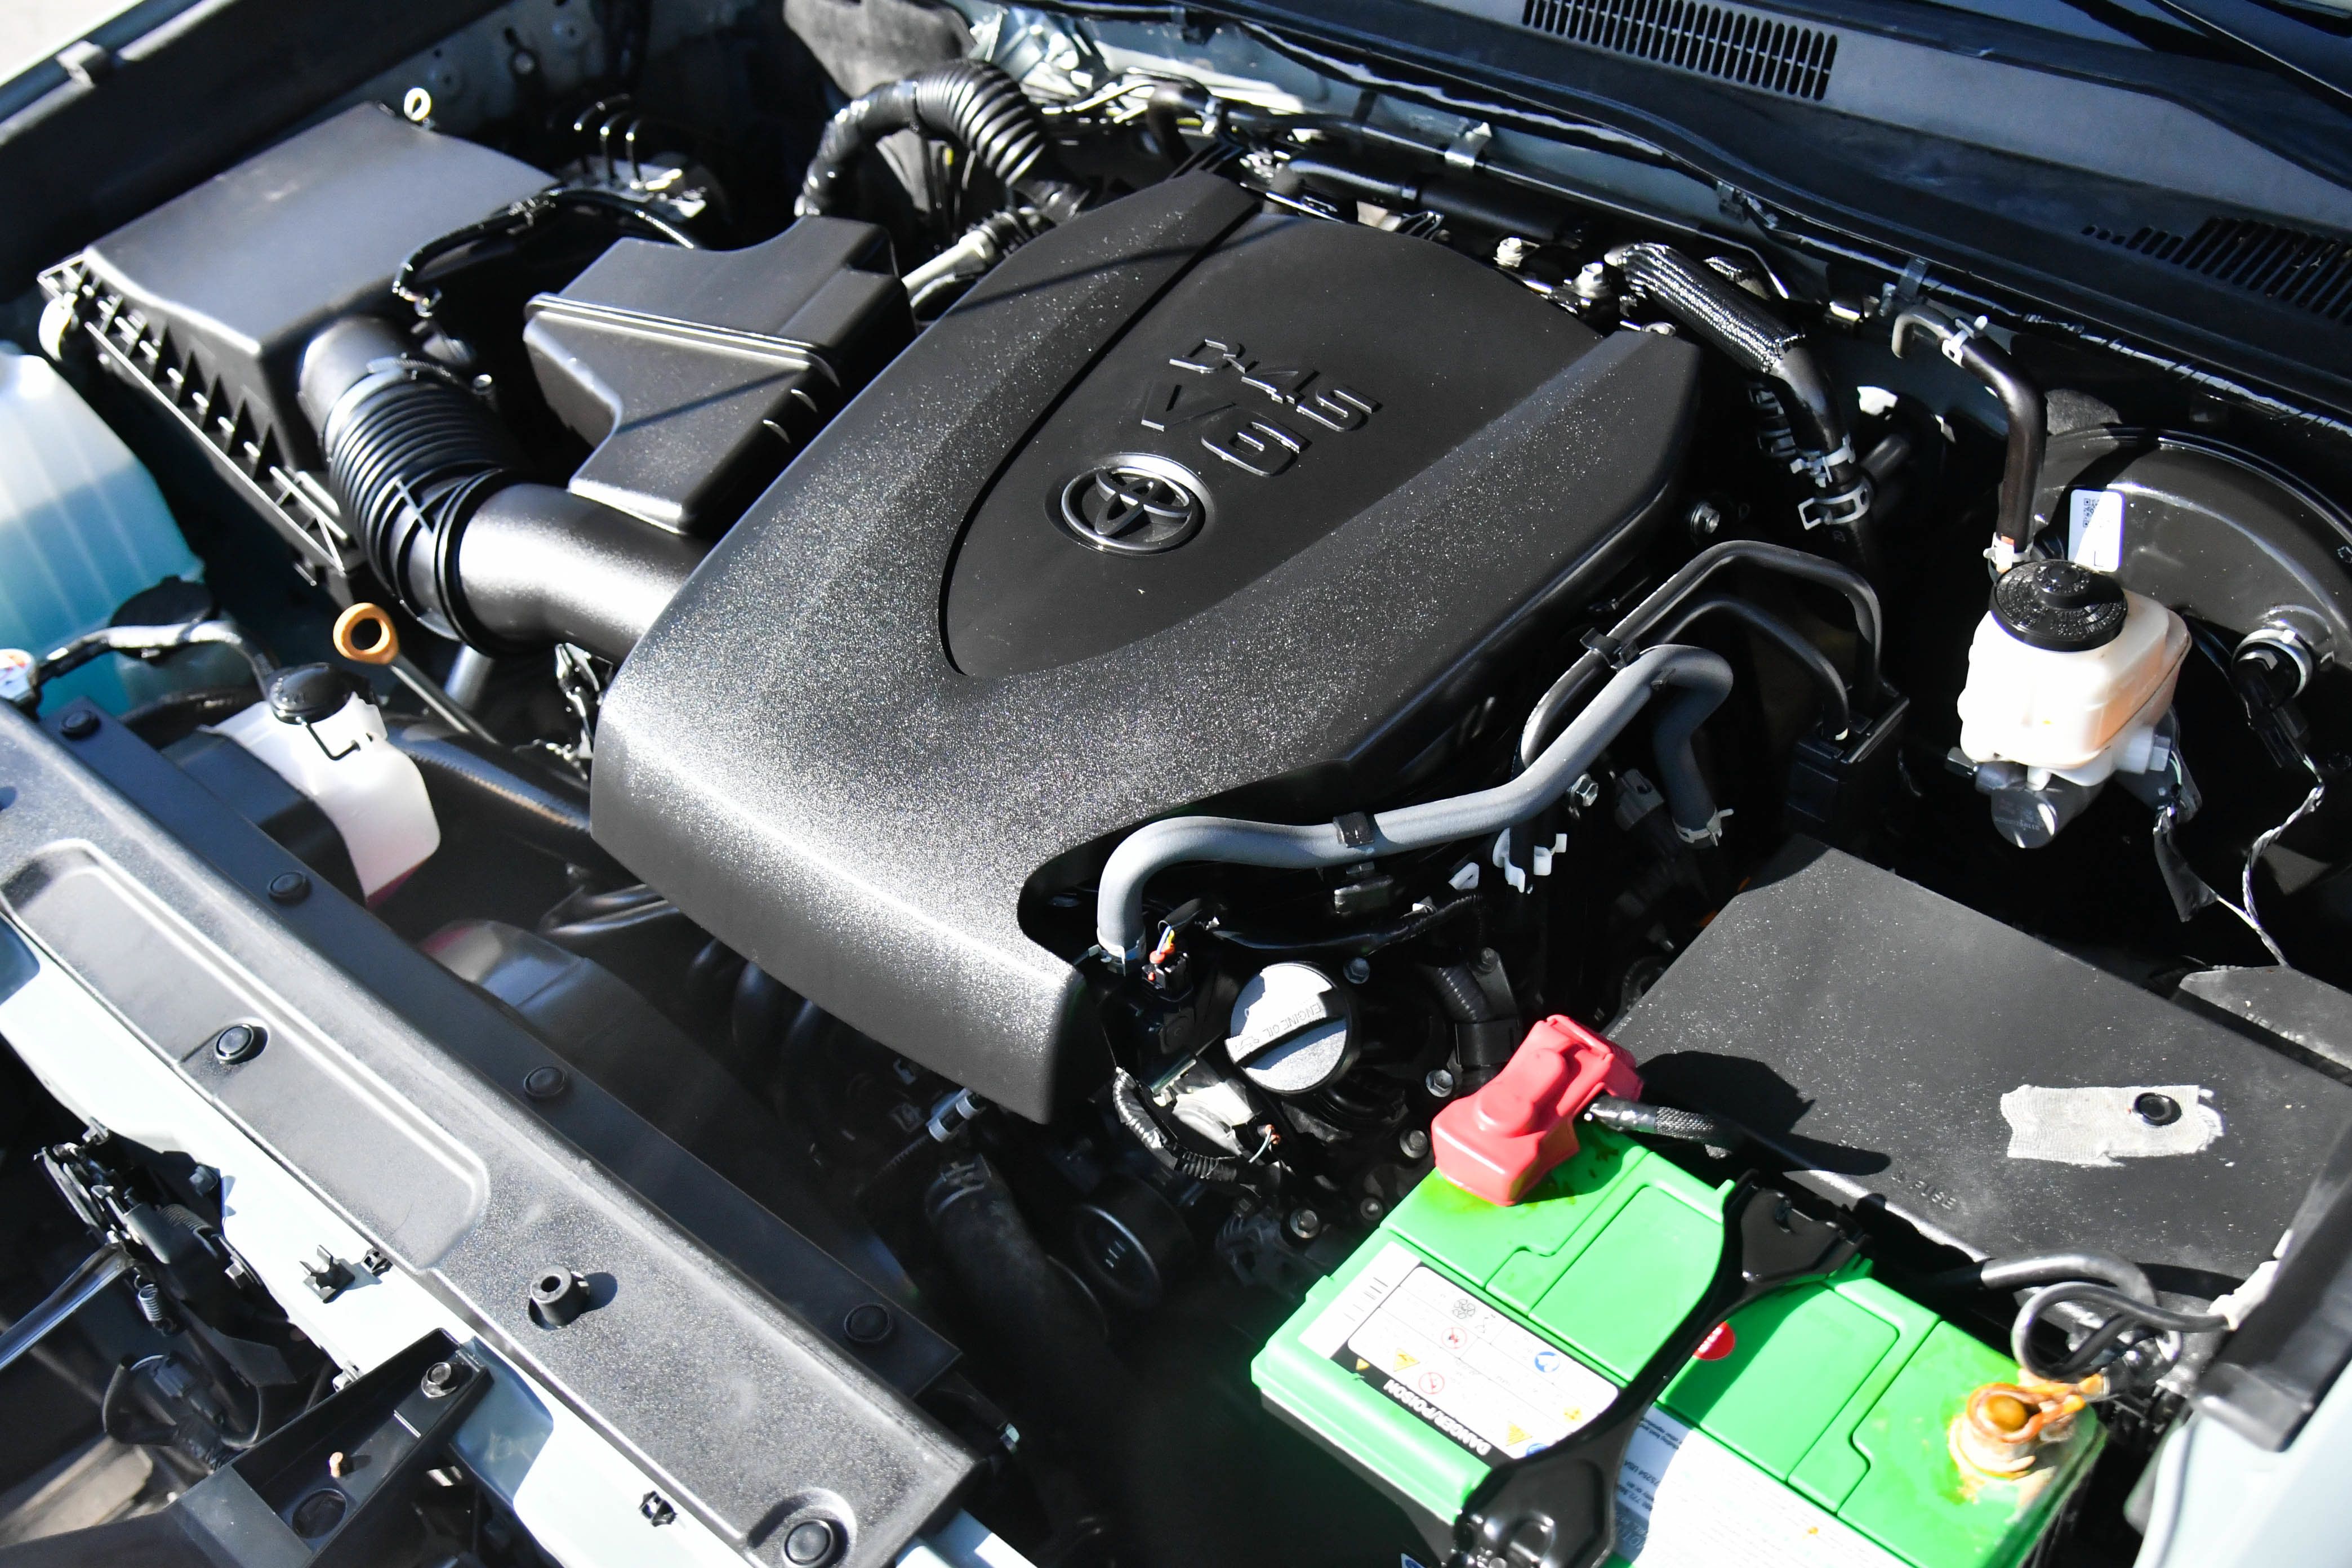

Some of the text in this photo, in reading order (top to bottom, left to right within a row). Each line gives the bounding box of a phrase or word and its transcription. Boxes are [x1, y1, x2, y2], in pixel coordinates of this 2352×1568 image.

[1141, 380, 1312, 477] V6
[1262, 1002, 1322, 1037] ENGINE OIL
[1909, 1180, 1957, 1210] FUSE
[1383, 1379, 1493, 1456] DANGER/POISON
